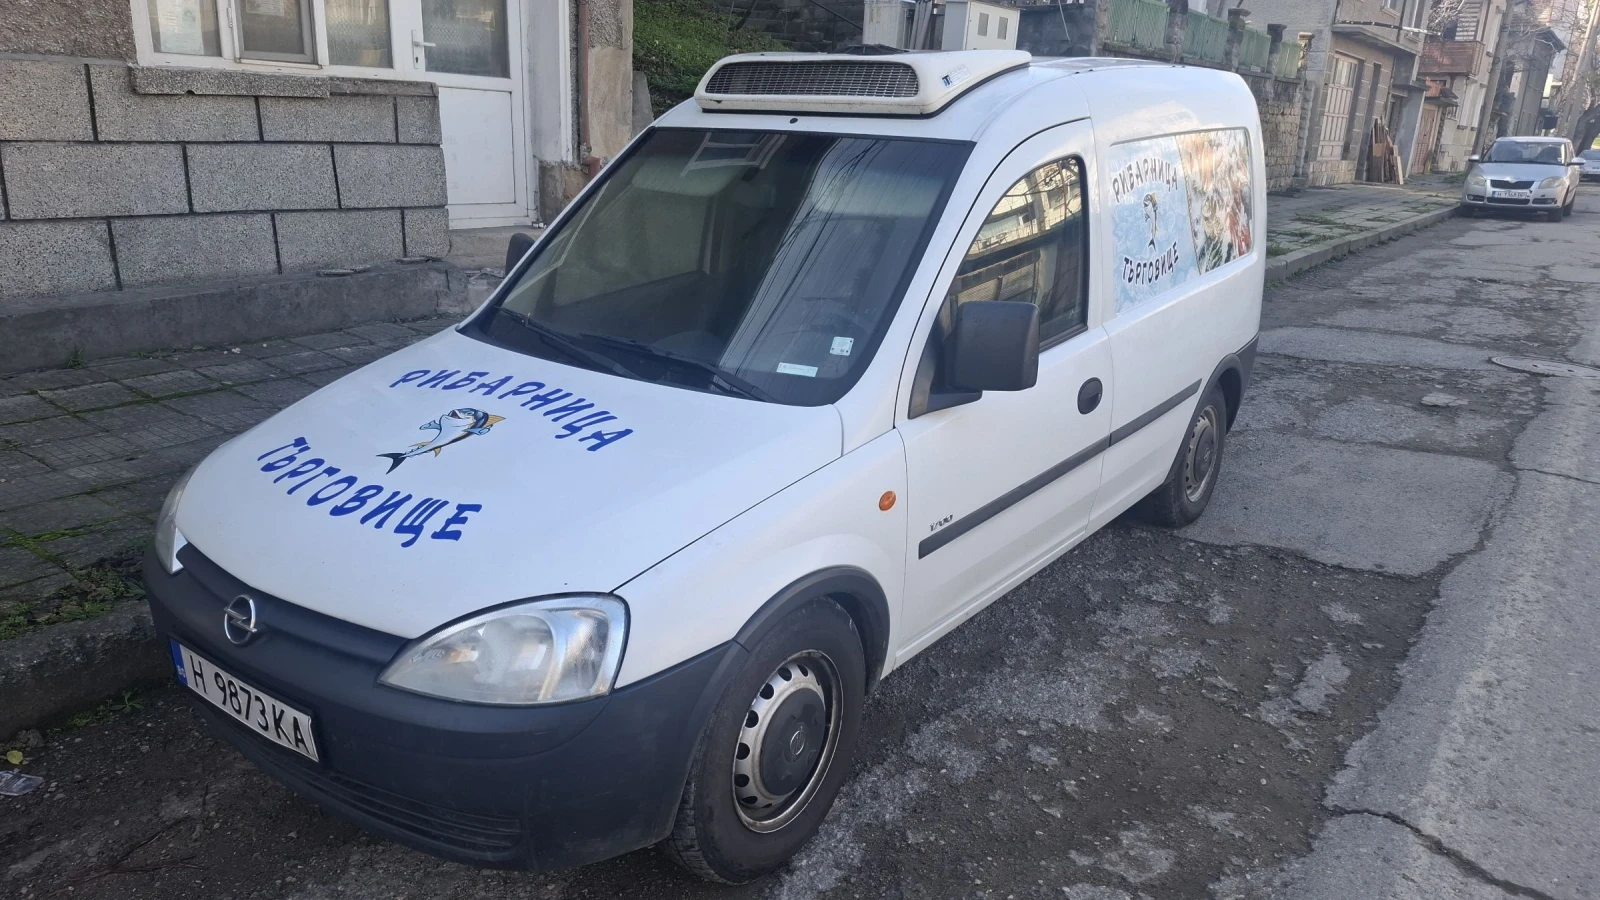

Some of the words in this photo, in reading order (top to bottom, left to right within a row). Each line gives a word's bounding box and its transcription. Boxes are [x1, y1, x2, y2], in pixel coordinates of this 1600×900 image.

[1113, 158, 1178, 203] РИБАРНИЦА
[1122, 241, 1179, 285] ТЪРГОВИЩЕ
[389, 369, 633, 451] РИБАРНИЦА
[257, 436, 482, 548] ТЪРГОВИЩЕ
